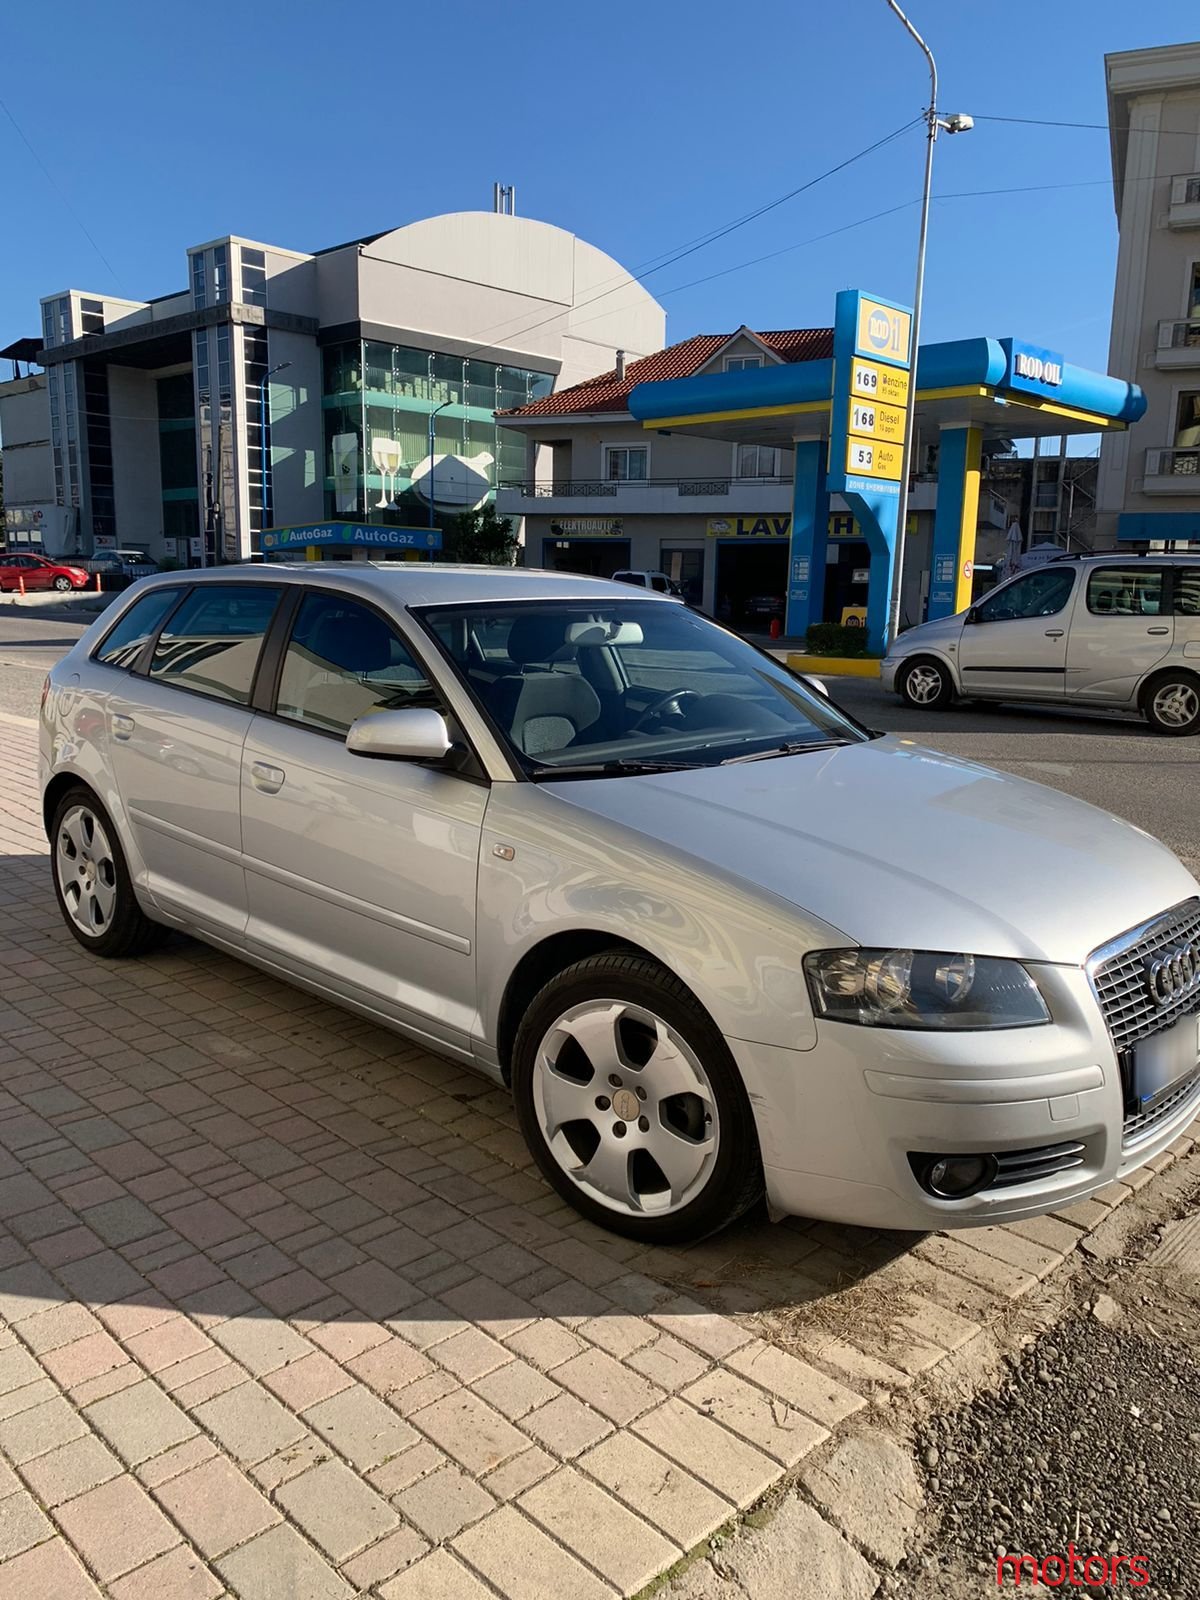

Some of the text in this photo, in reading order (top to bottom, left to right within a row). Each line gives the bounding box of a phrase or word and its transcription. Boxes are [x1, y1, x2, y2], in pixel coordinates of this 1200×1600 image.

[1016, 353, 1063, 386] ROD OIL
[856, 372, 908, 390] 169 Benzine
[854, 408, 900, 426] 168 Diesel
[858, 450, 894, 464] 53 Auto
[289, 528, 333, 541] AutoGaz
[354, 527, 414, 544] AutoGaz
